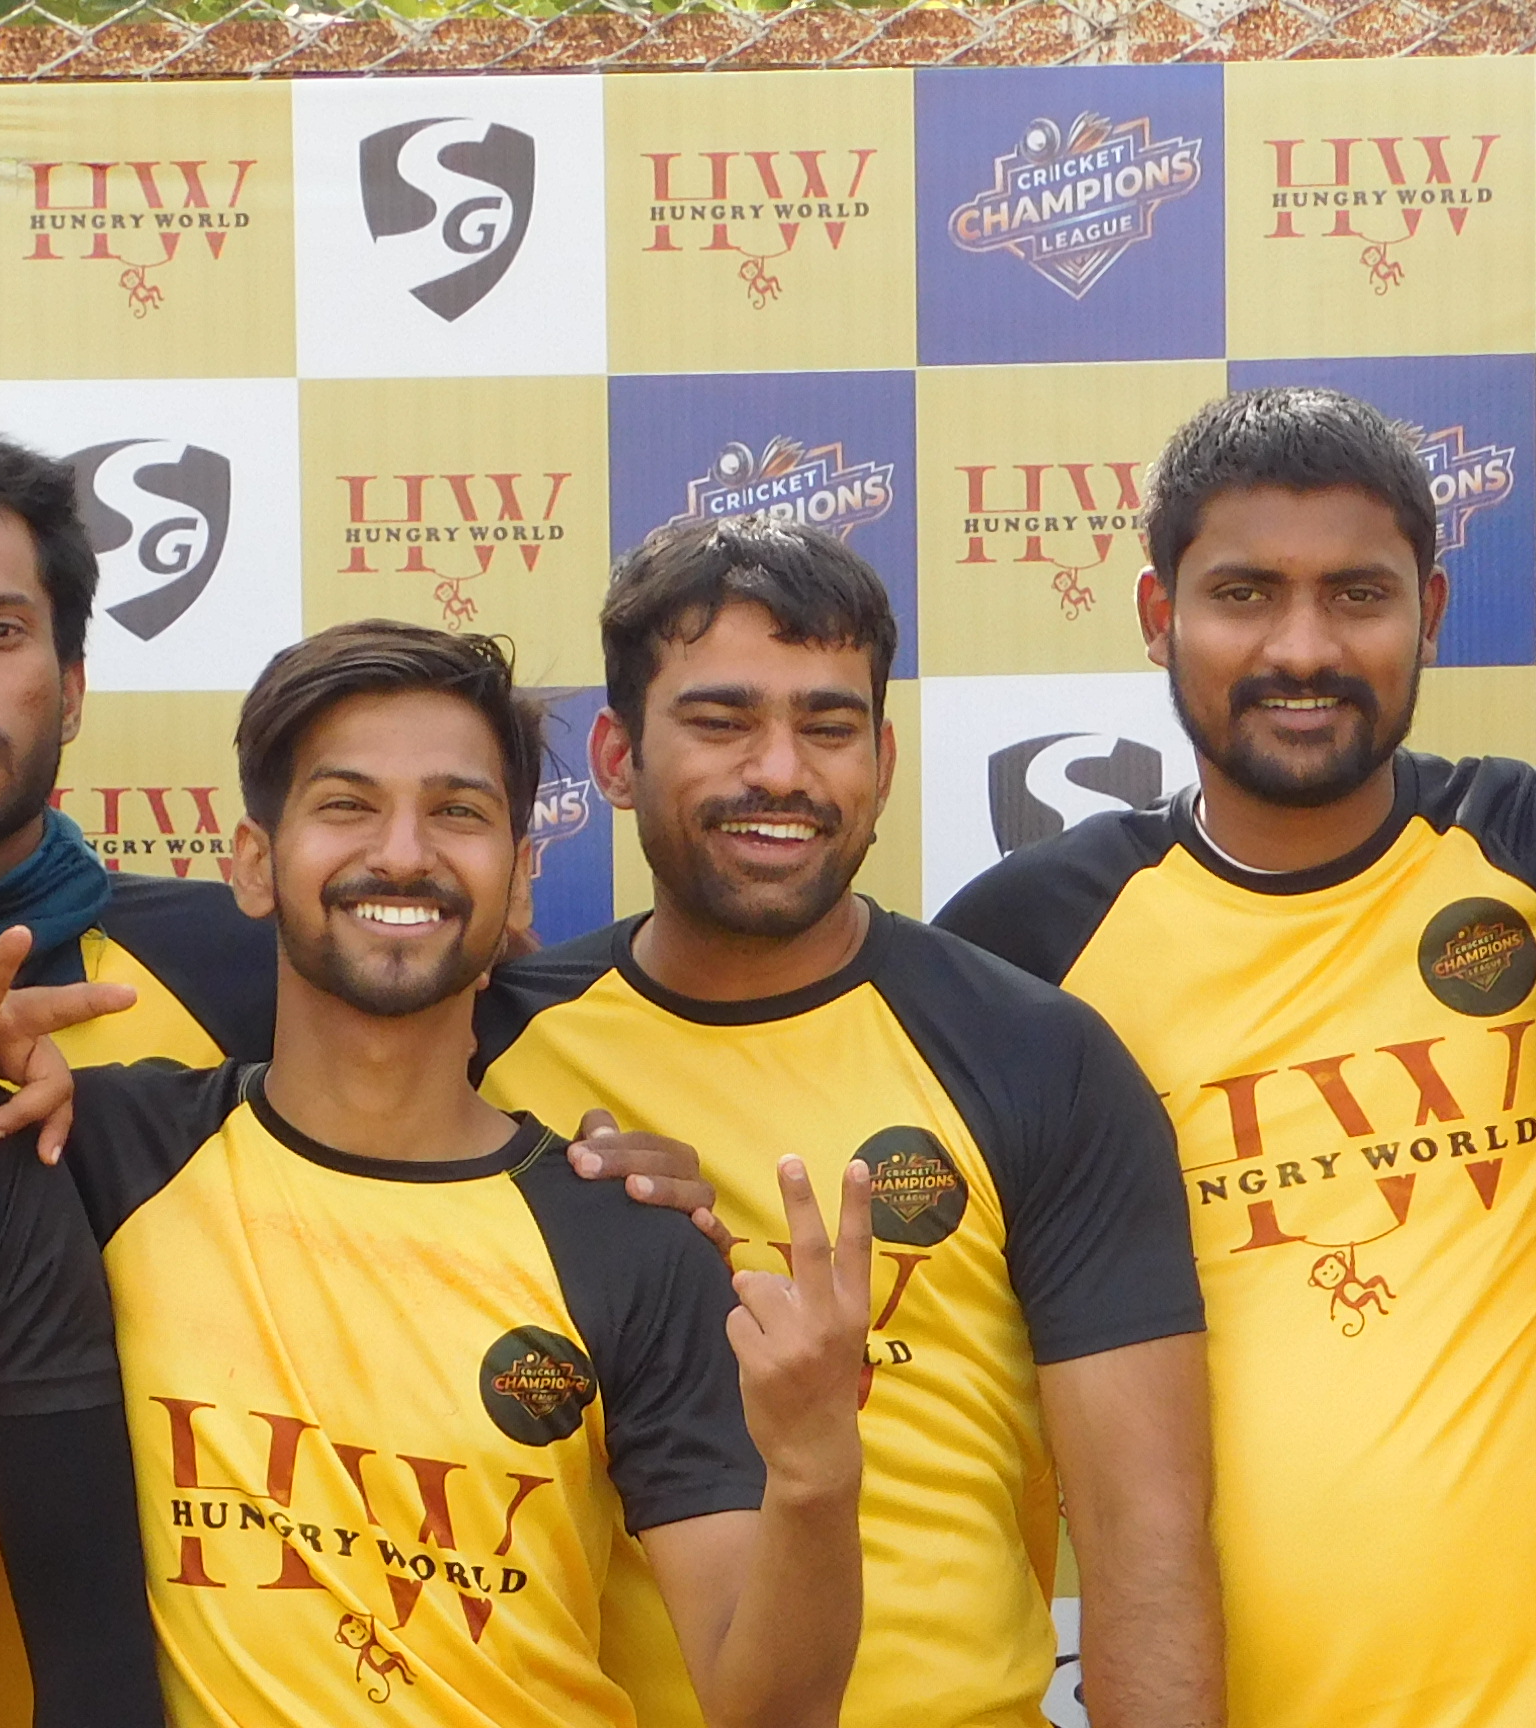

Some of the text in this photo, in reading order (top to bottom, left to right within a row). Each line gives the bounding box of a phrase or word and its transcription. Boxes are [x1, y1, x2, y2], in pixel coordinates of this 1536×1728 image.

[640, 149, 877, 251] HW
[956, 150, 1194, 241] CHAMPIONS
[1264, 135, 1500, 238] HW
[1272, 187, 1492, 208] HUNGRY WORLD
[22, 160, 257, 260] HW
[30, 211, 250, 231] HUNGRY WORLD
[650, 202, 870, 221] HUNGRY WORLD
[1041, 213, 1133, 252] LEAGUE
[336, 473, 572, 573] HW
[769, 476, 885, 526] PIONS
[345, 525, 564, 543] HUNGRY WORLD
[964, 517, 1078, 534] HUNGRY
[86, 839, 233, 854] NGRY WOR
[1435, 933, 1522, 974] CHAMPIONS
[871, 1174, 955, 1192] HAMPIONS
[1192, 1152, 1341, 1206] NGRY
[149, 1396, 554, 1645] HW
[172, 1499, 528, 1595] HUNGRY WORLD
